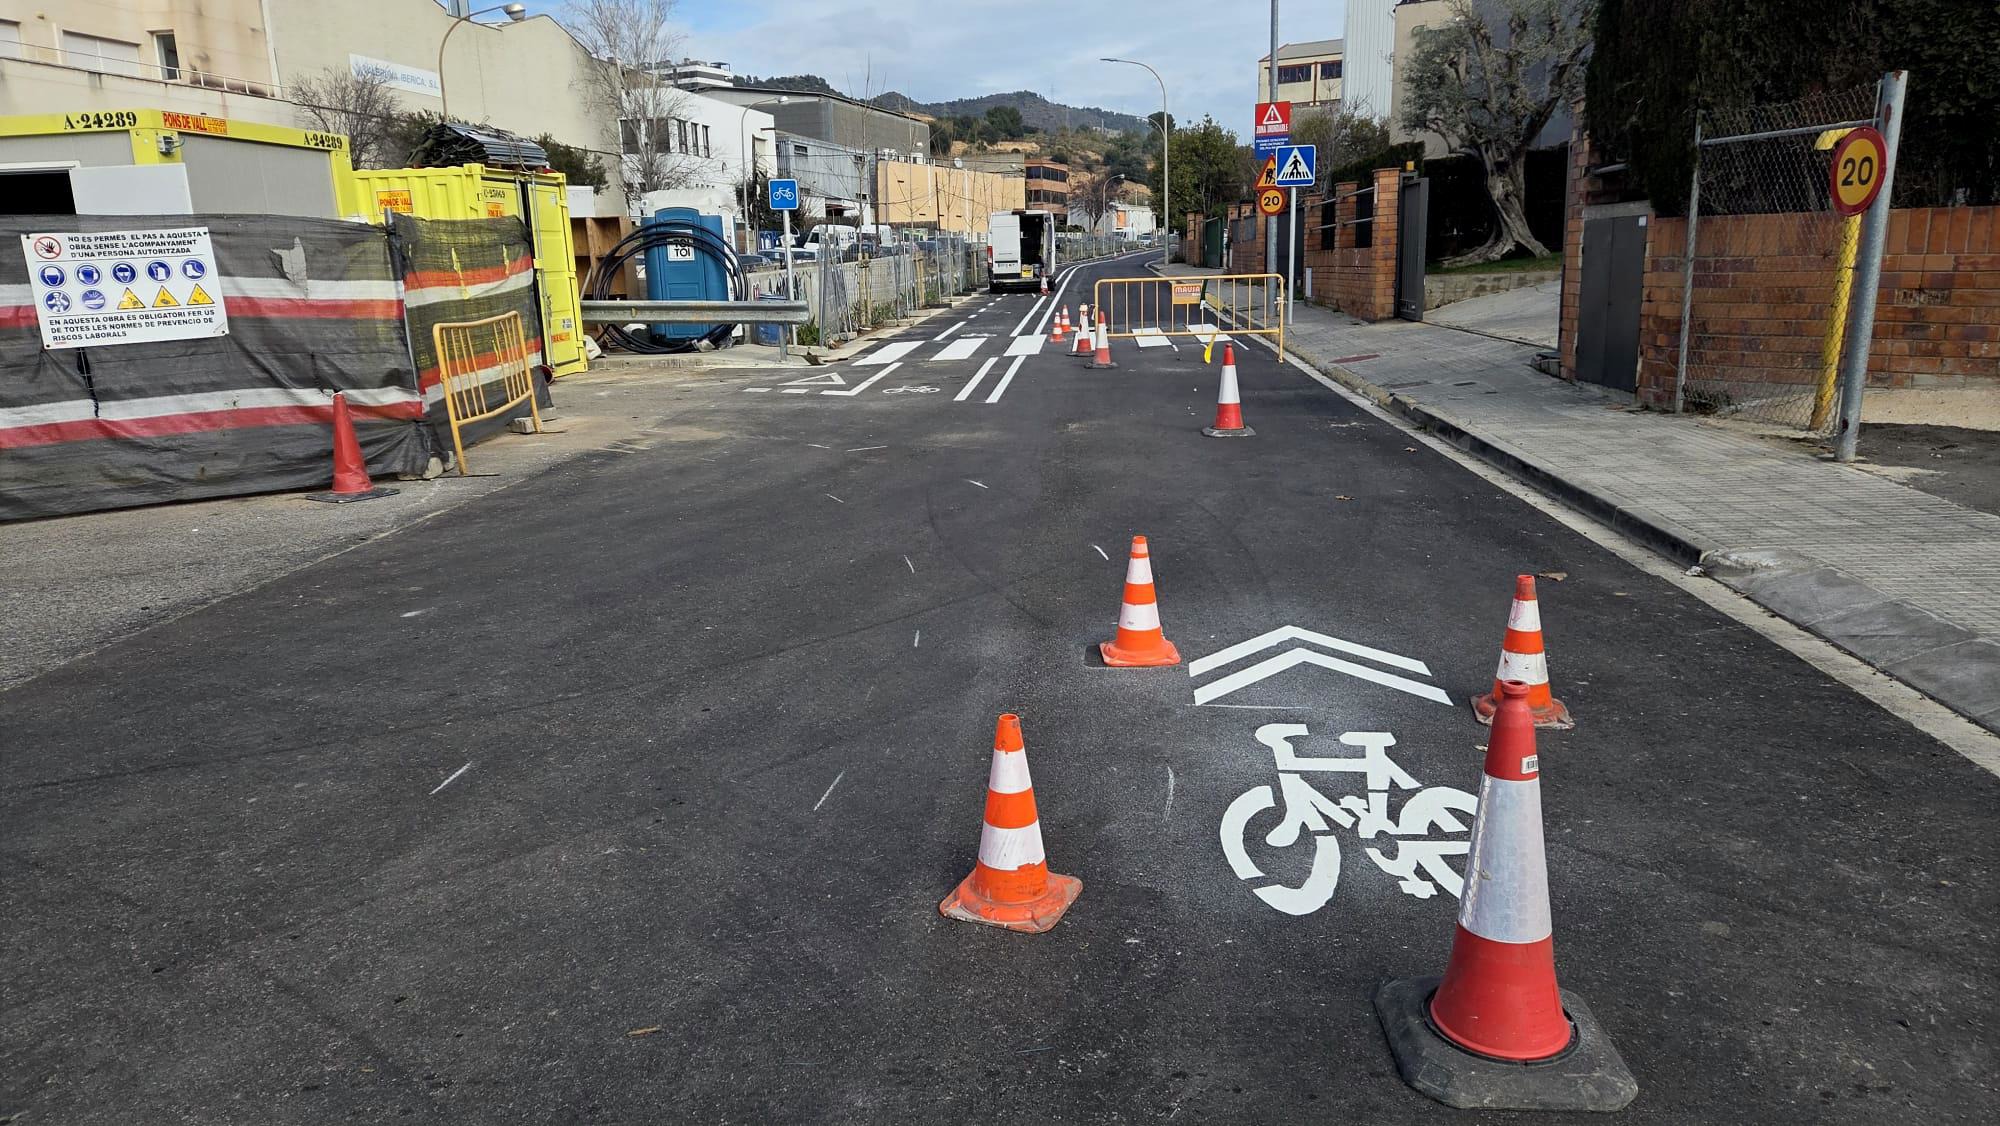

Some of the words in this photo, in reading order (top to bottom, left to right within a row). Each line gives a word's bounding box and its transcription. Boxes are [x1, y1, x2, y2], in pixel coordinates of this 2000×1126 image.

[163, 112, 181, 128] PONS
[181, 115, 191, 128] DE
[191, 116, 207, 130] VALL
[1841, 156, 1874, 186] 20
[1264, 196, 1280, 206] 20
[122, 240, 197, 248] L'ACOMPANYAMENT
[674, 248, 690, 257] TOI
[85, 331, 127, 339] LABORALS
